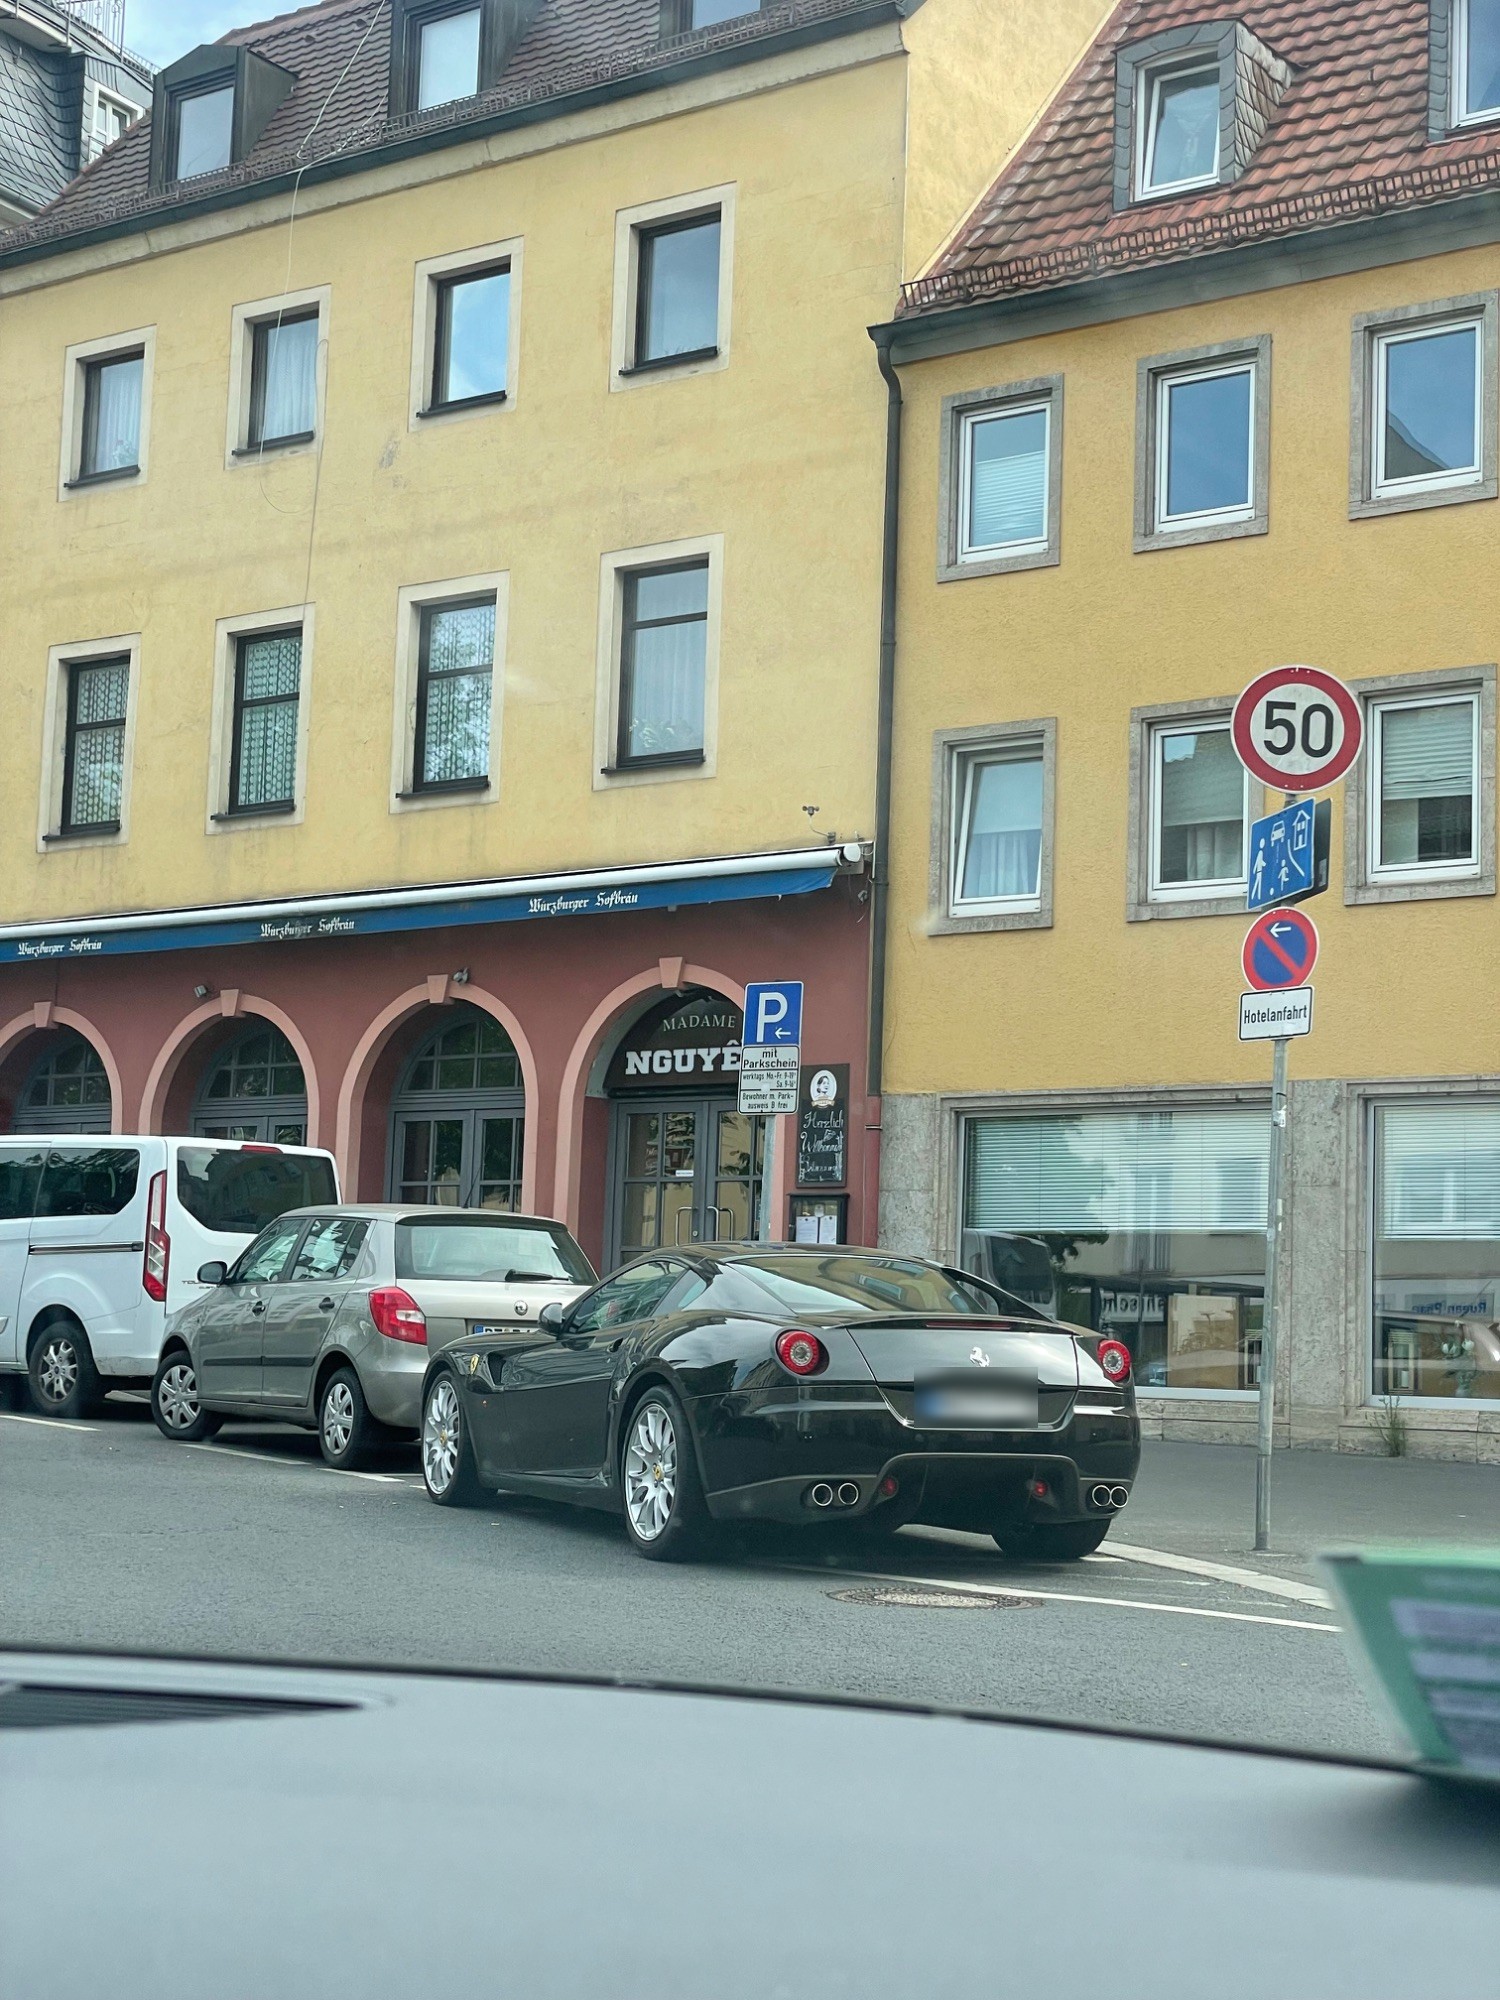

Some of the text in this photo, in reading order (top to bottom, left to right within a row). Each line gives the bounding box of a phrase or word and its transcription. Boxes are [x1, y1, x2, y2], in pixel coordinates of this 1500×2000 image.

[1264, 700, 1334, 758] 50
[528, 890, 638, 915] Würzburger Hofbräu
[317, 917, 355, 934] Hofbräu
[662, 1014, 736, 1032] MADAME
[756, 992, 788, 1043] P
[1243, 1005, 1307, 1024] Hotelanfahrt
[625, 1039, 742, 1075] NGUYÊ
[762, 1047, 777, 1058] mit
[743, 1058, 797, 1069] Parkschein
[743, 1073, 765, 1081] werktags
[778, 1101, 788, 1109] frei
[803, 1109, 844, 1129] Herzlich
